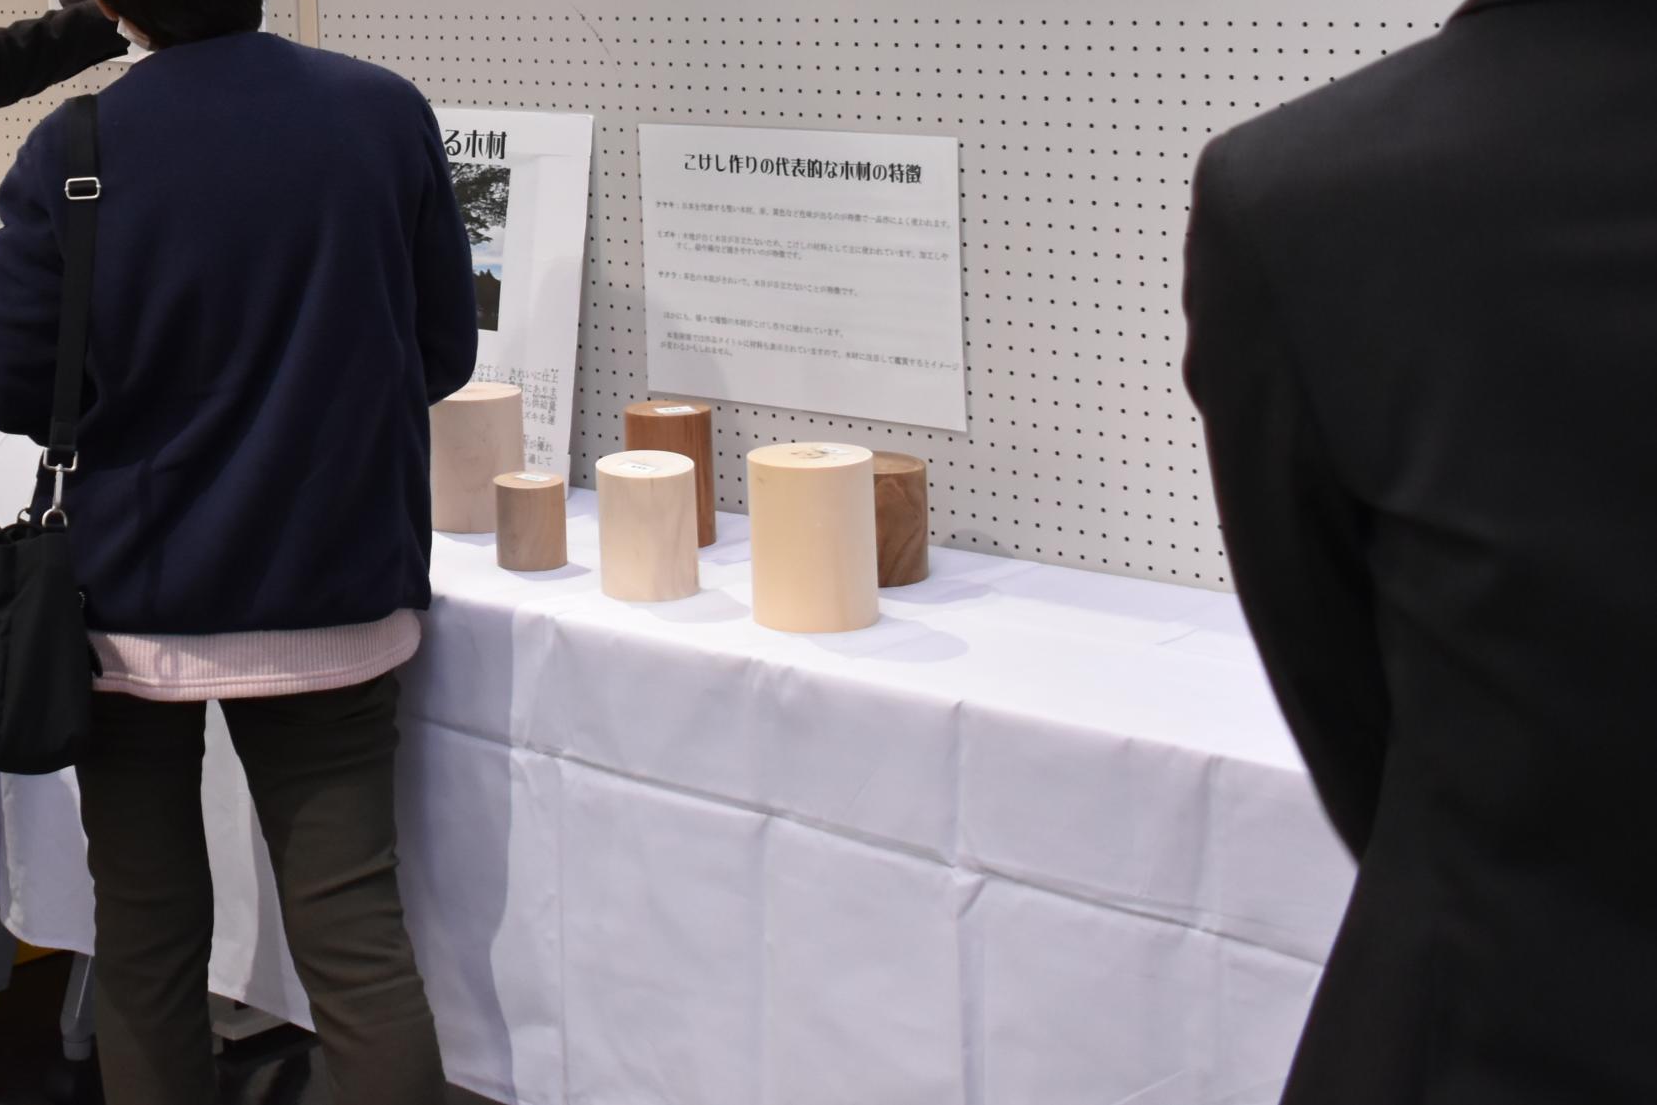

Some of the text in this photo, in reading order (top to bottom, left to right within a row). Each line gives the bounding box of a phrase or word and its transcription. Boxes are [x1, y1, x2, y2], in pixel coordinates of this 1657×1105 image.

[444, 129, 507, 159] る木材
[683, 152, 922, 184] こけし作りの代表的な木材の特徴
